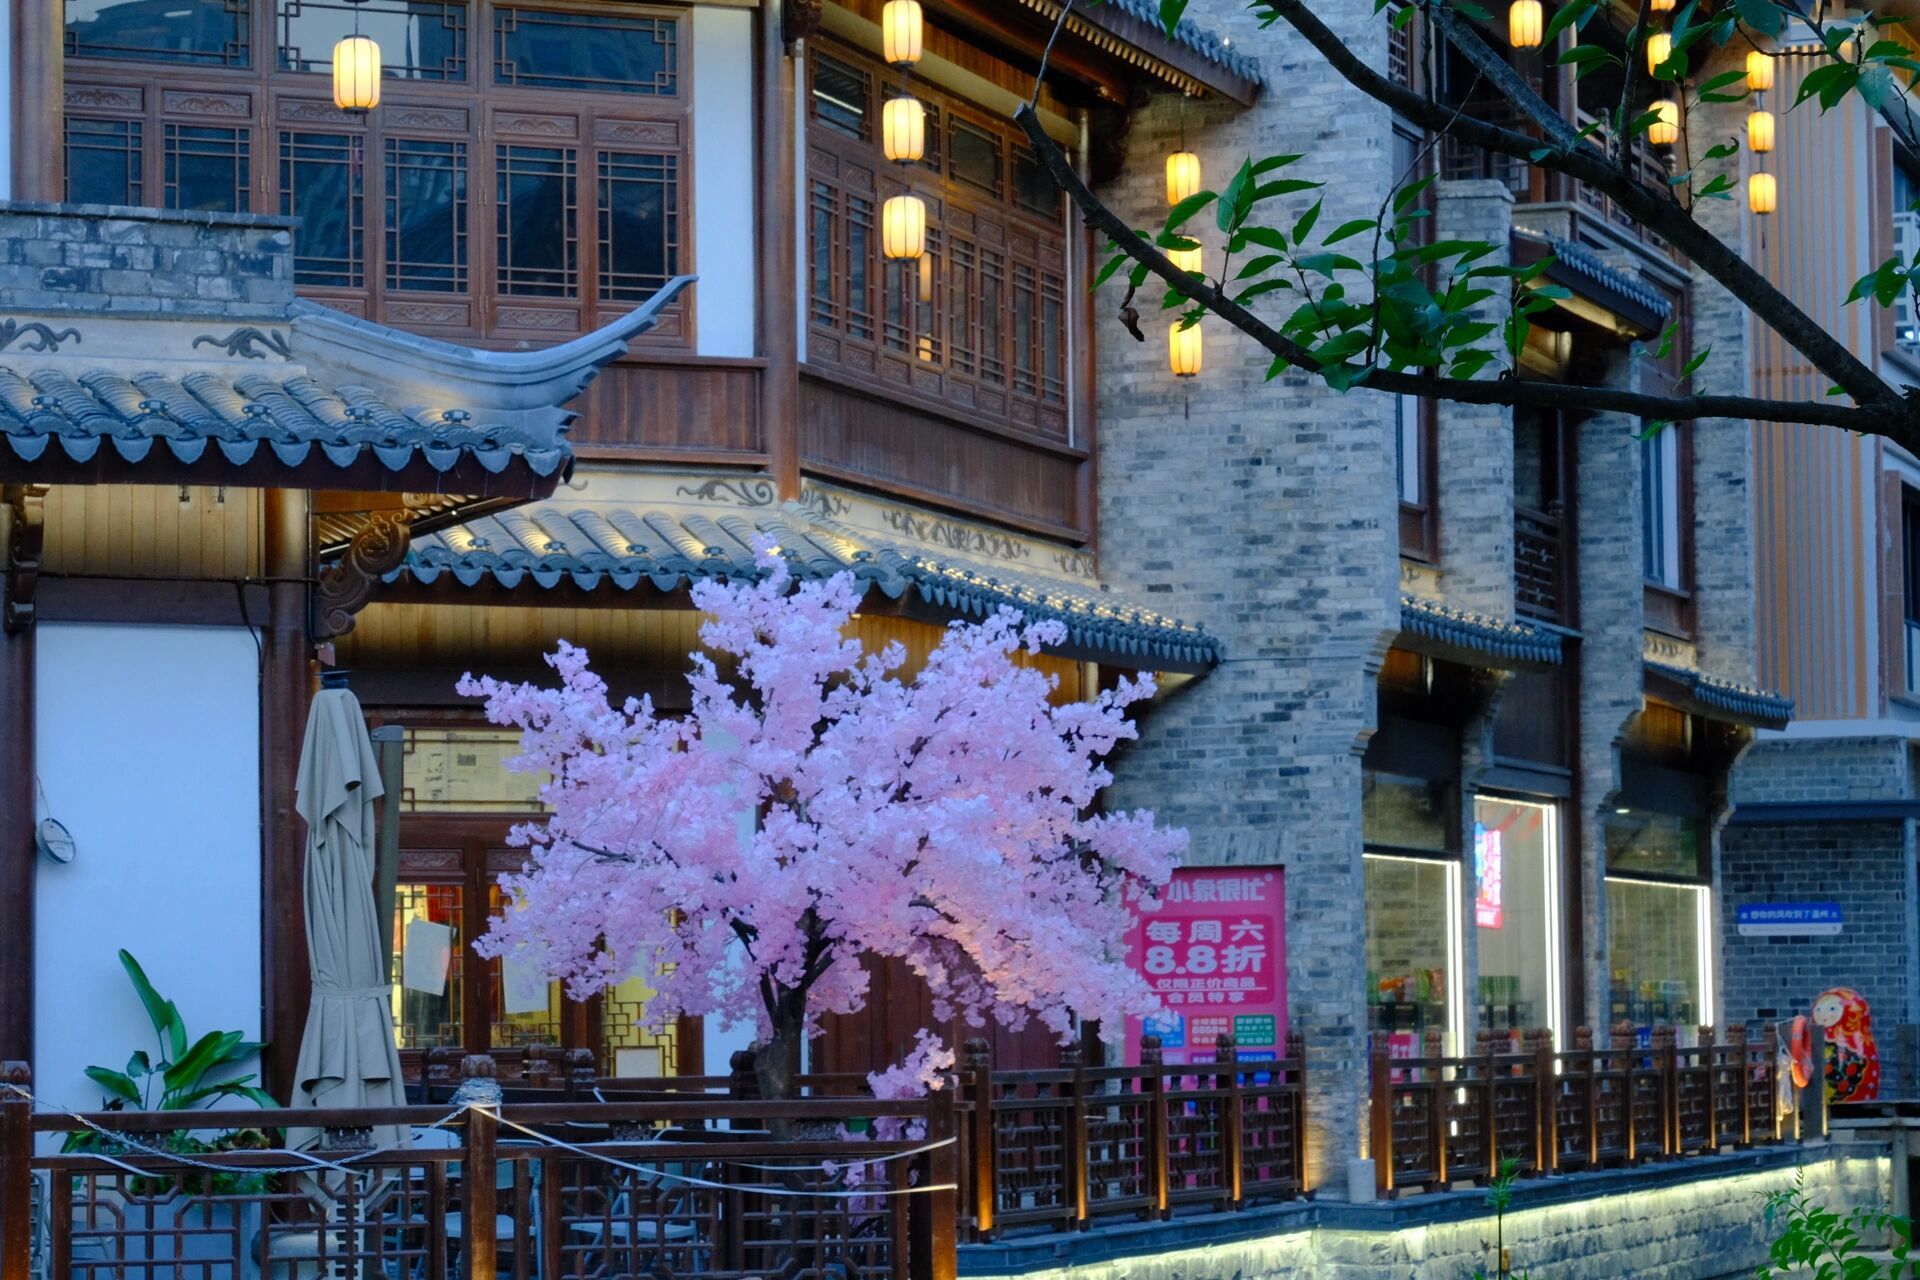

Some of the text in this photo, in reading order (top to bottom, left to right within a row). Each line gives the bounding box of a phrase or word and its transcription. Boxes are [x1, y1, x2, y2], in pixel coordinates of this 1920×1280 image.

[1146, 919, 1264, 944] 每周六
[1144, 945, 1266, 974] 8.8折
